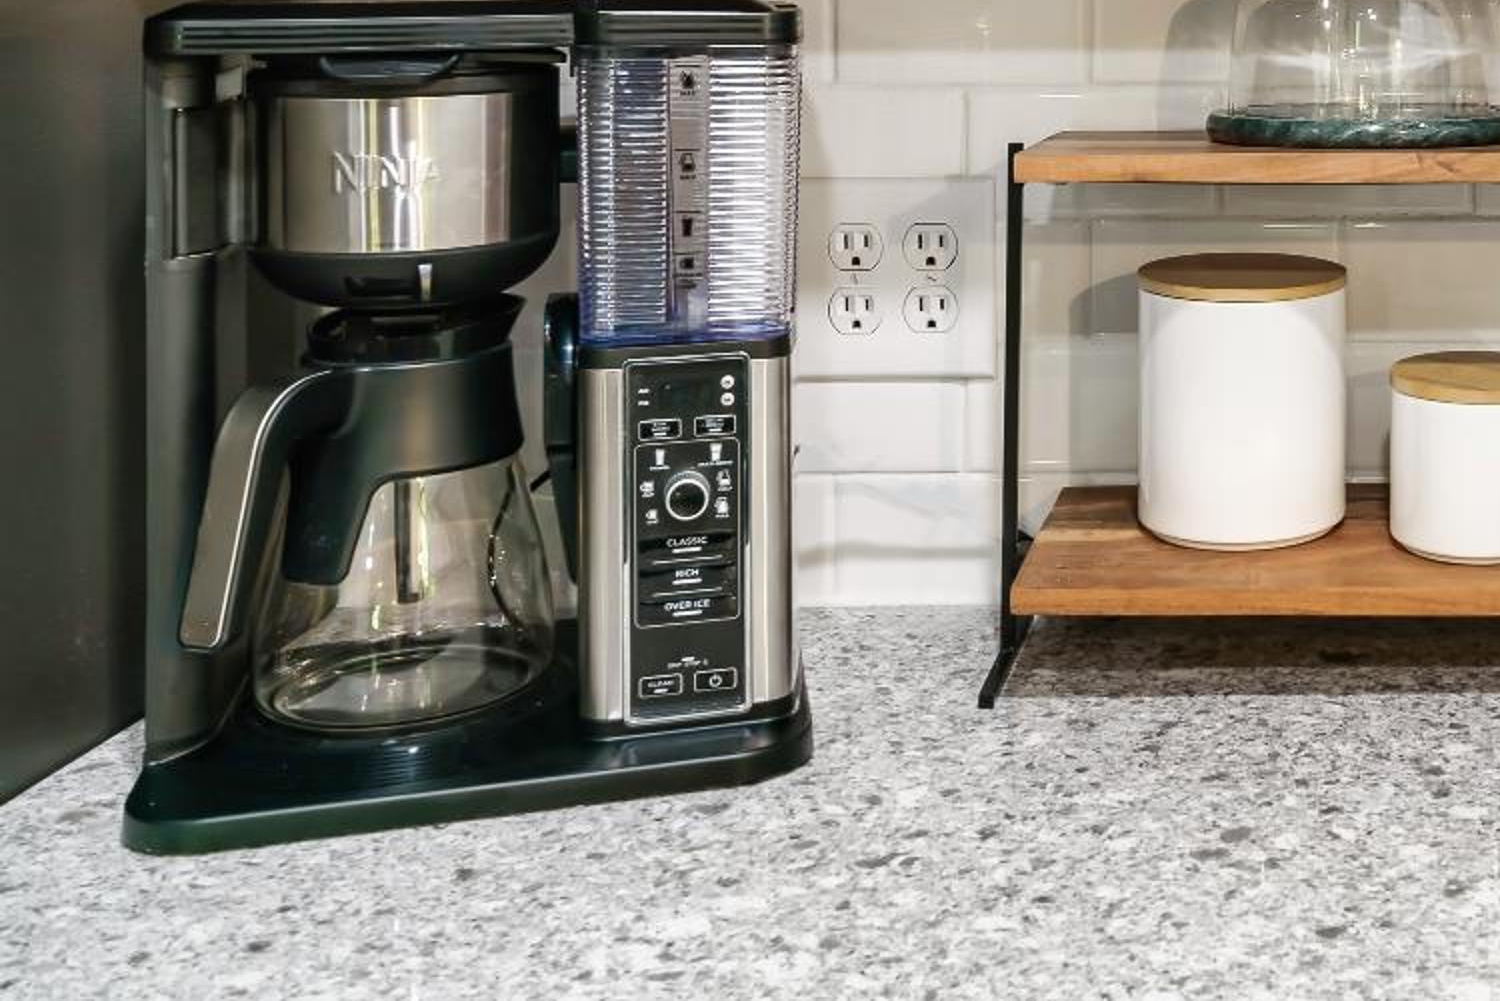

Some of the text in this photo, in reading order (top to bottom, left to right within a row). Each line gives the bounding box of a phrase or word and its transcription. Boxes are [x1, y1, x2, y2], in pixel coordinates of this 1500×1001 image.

[332, 148, 442, 198] NINJA
[665, 536, 709, 548] CLASSIC
[675, 568, 700, 578] RICH
[664, 598, 711, 611] OVER ICE
